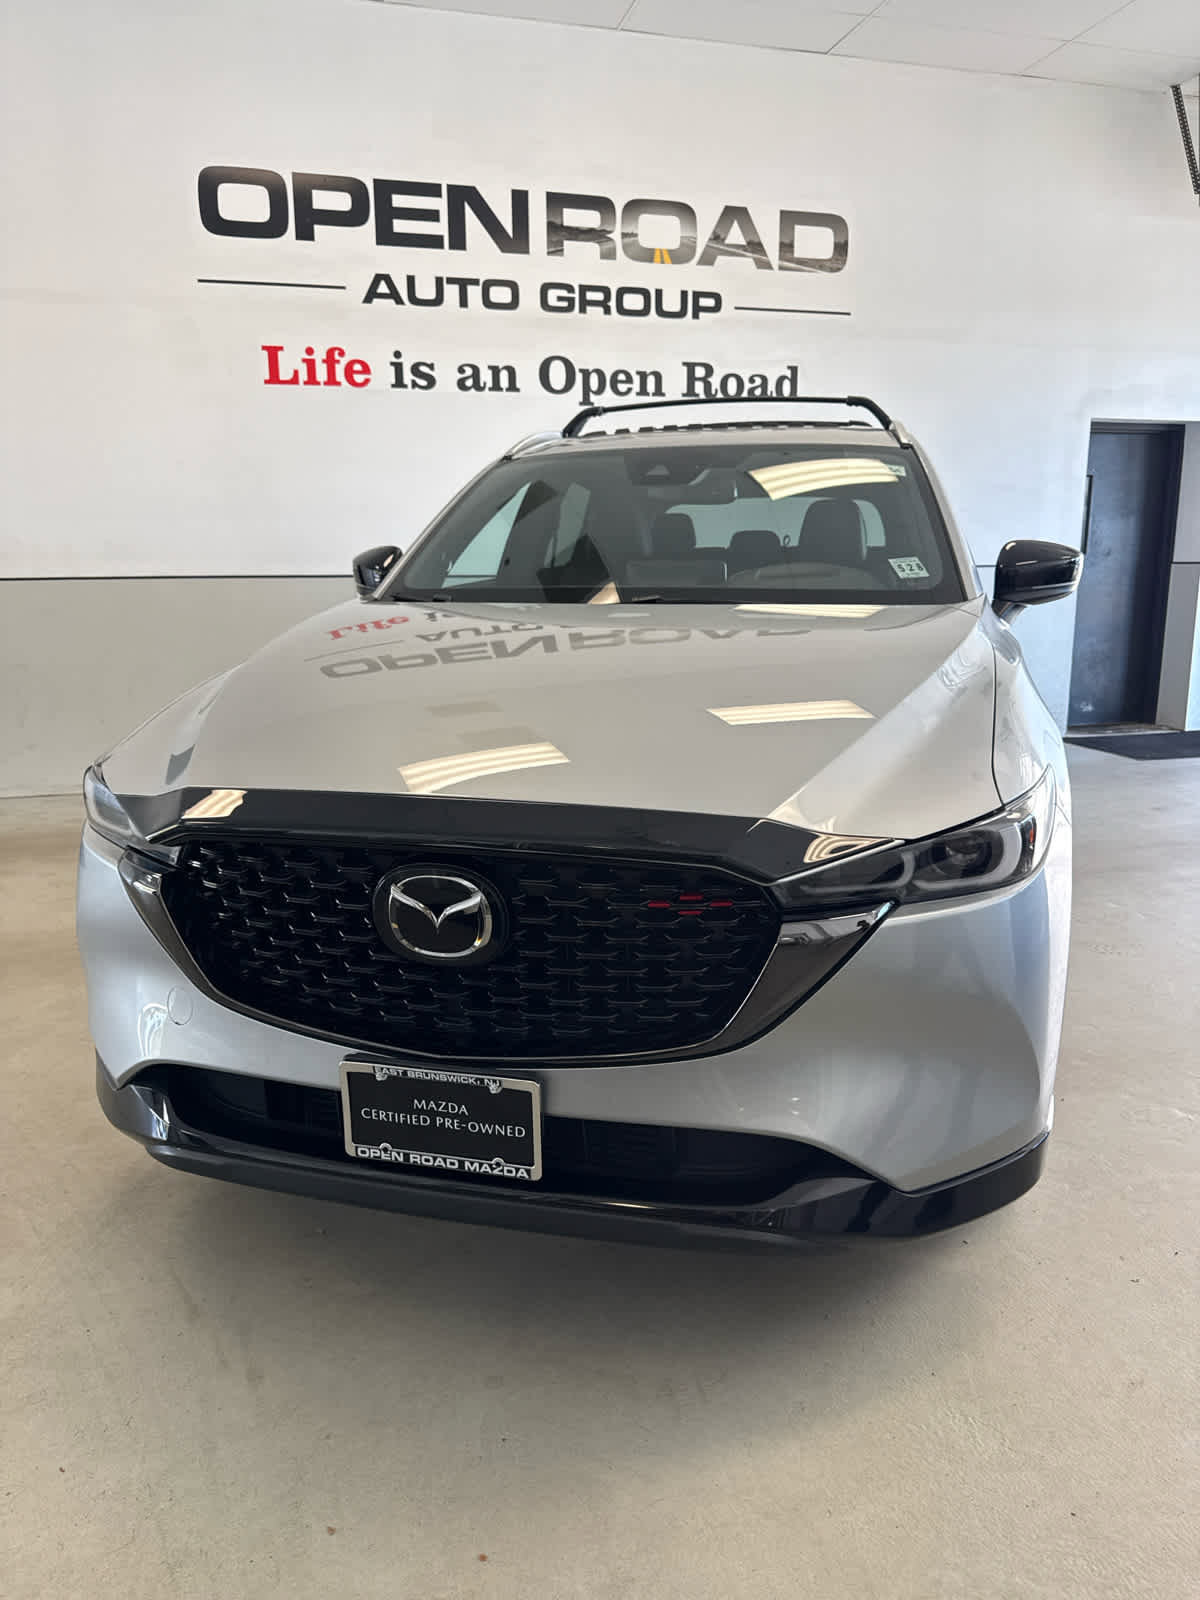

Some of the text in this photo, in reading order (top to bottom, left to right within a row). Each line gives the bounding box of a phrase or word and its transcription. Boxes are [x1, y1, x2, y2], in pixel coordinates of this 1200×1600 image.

[197, 165, 850, 274] OPEN ROAD
[361, 273, 722, 320] AUTO GROUP
[261, 344, 799, 406] Life is an Open Road
[374, 1066, 403, 1077] EAST
[360, 1107, 526, 1138] CERTIFIED PRE-OWNED
[413, 1099, 469, 1116] MAZDA
[357, 1147, 529, 1179] OPEN ROAD MAZDA
